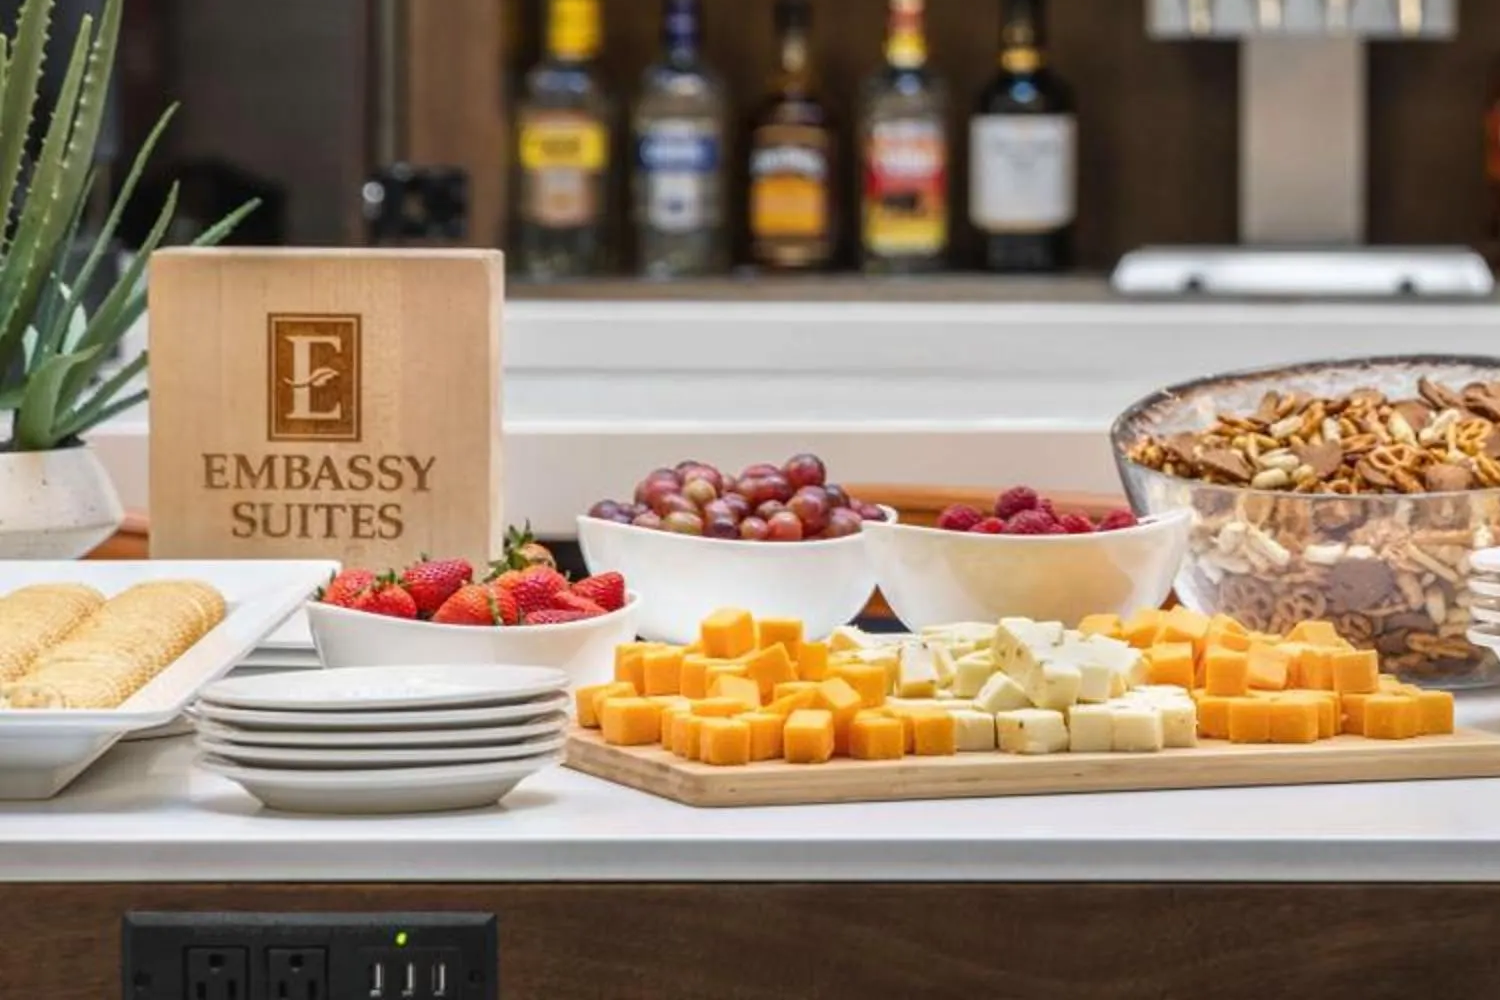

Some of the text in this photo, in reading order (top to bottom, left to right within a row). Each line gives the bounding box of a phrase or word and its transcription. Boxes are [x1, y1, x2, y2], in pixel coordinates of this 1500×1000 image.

[284, 335, 342, 420] E
[202, 453, 436, 492] EMBASSY
[231, 501, 404, 540] SUITES
